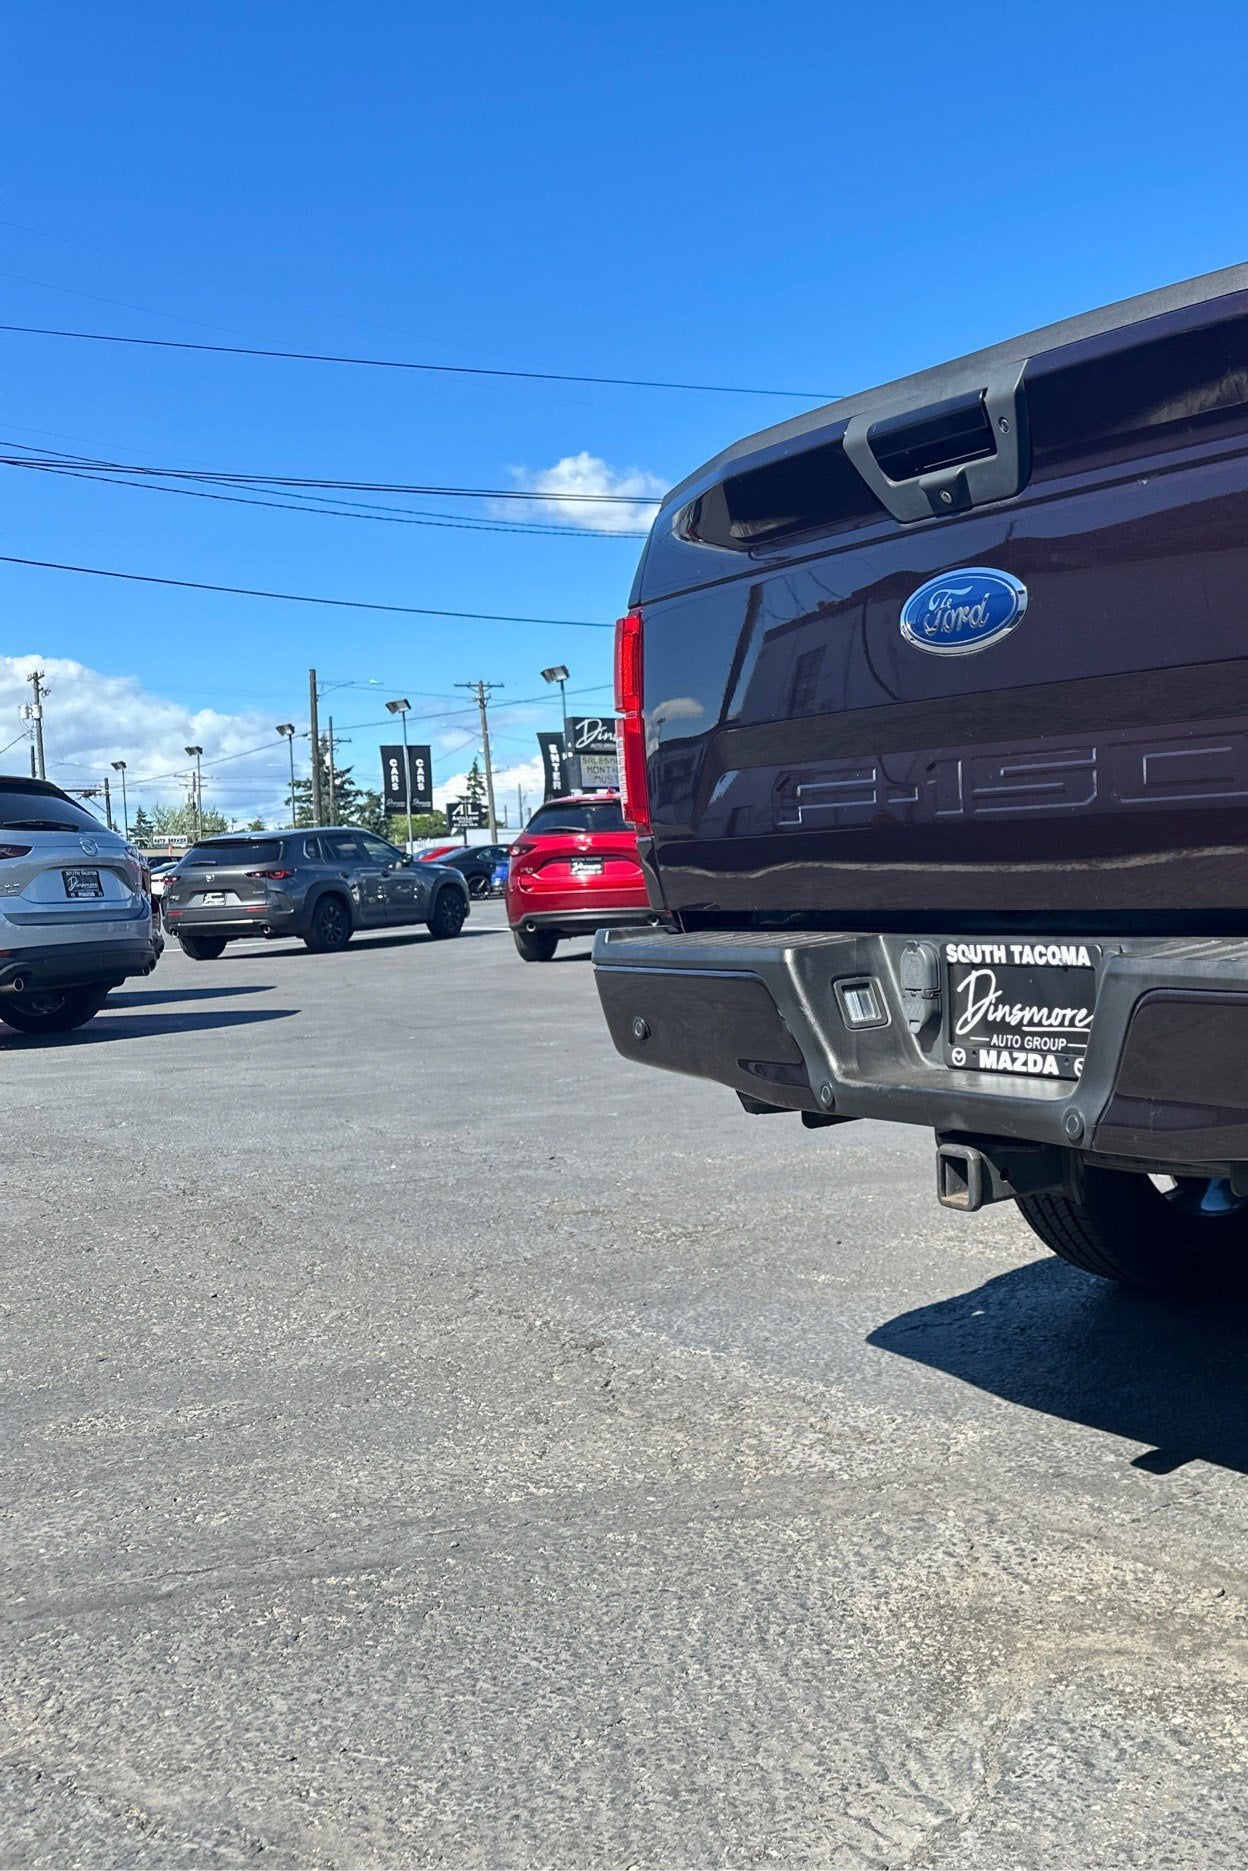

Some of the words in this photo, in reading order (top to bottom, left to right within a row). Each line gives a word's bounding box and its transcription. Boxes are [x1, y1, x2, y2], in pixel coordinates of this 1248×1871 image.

[923, 585, 991, 637] Ford
[389, 758, 399, 791] CARS
[415, 758, 425, 791] CARS
[548, 744, 561, 790] ENTER
[946, 944, 1006, 964] SOUTH
[1010, 945, 1091, 966] TACOMA
[956, 969, 1094, 1035] Dinsmore
[990, 1034, 1021, 1047] AUTO
[1024, 1036, 1067, 1050] GROUP
[979, 1049, 1060, 1075] MAZDA
